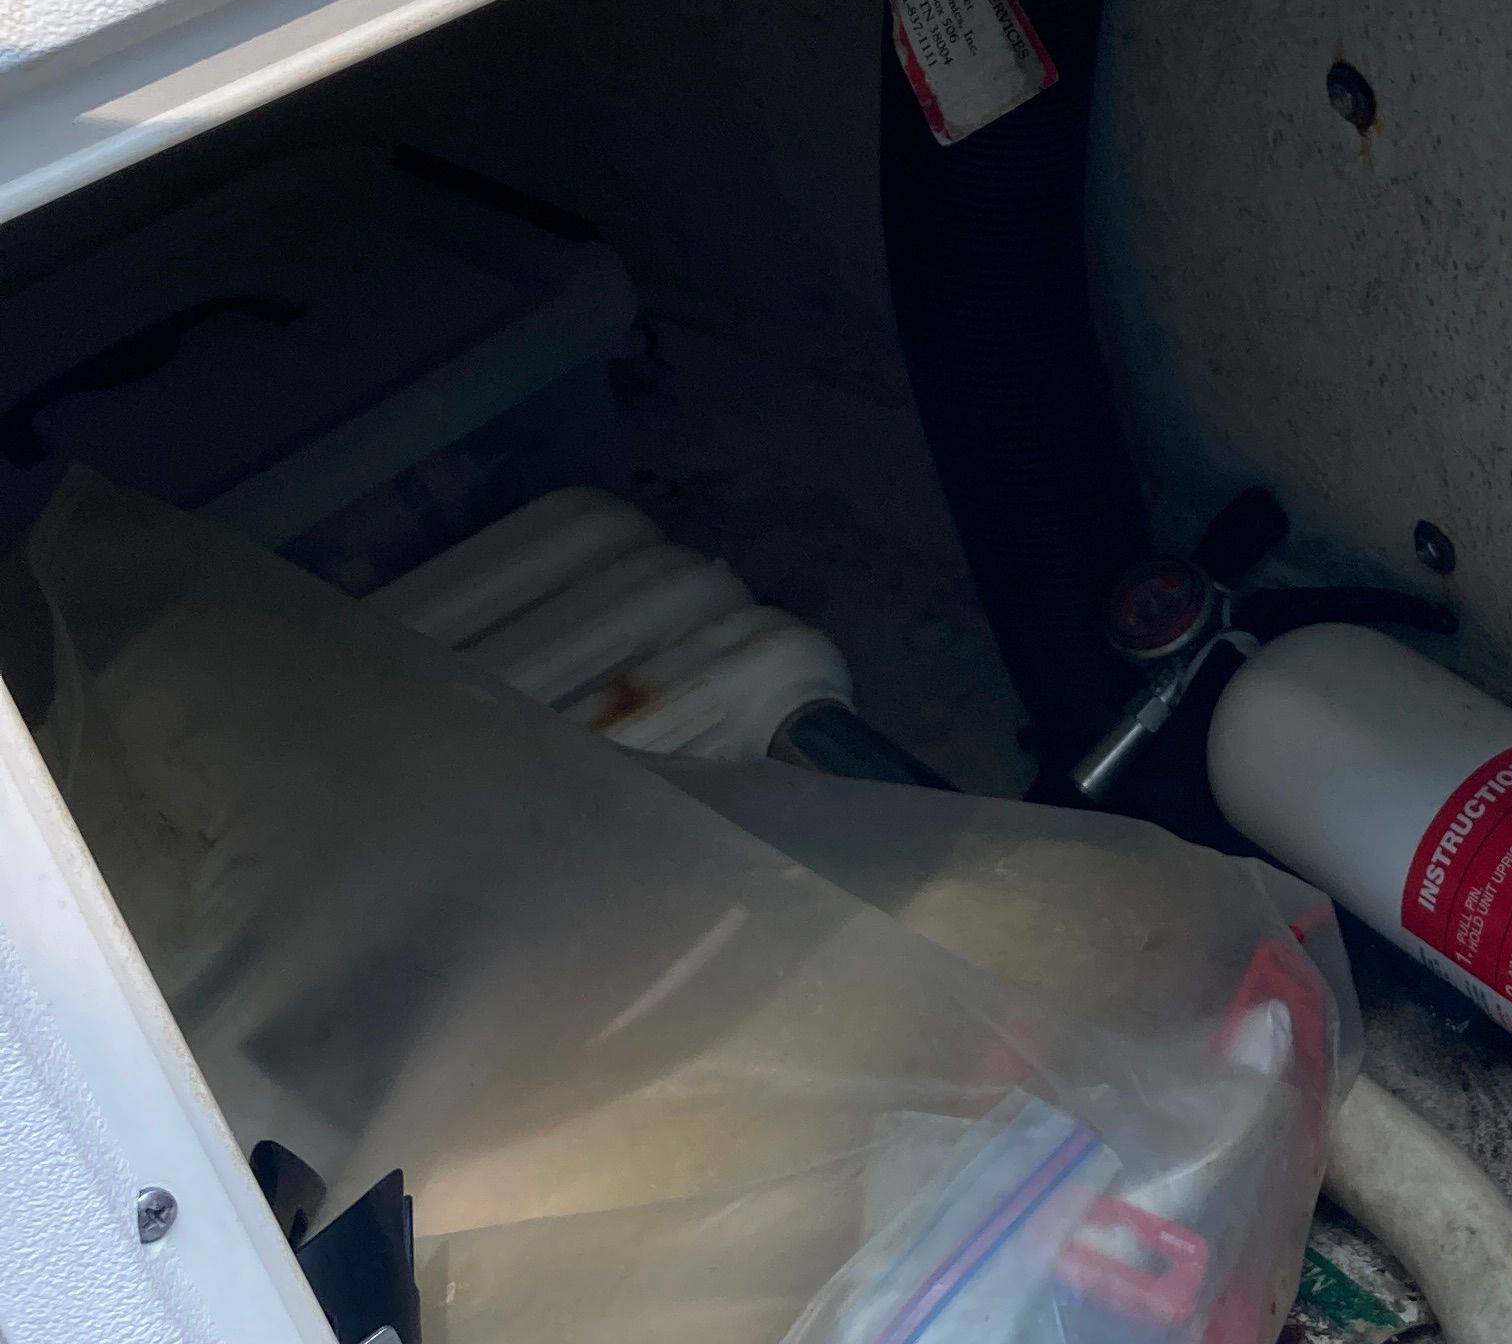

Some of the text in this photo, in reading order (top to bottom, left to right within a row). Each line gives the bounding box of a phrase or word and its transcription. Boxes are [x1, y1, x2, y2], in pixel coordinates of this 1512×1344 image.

[930, 24, 953, 66] 38004
[942, 17, 960, 45] 506
[963, 29, 978, 57] Inc.
[1455, 886, 1484, 967] 1. PULL PIN.
[1468, 915, 1484, 953] HOLD
[1478, 882, 1497, 916] UNIT
